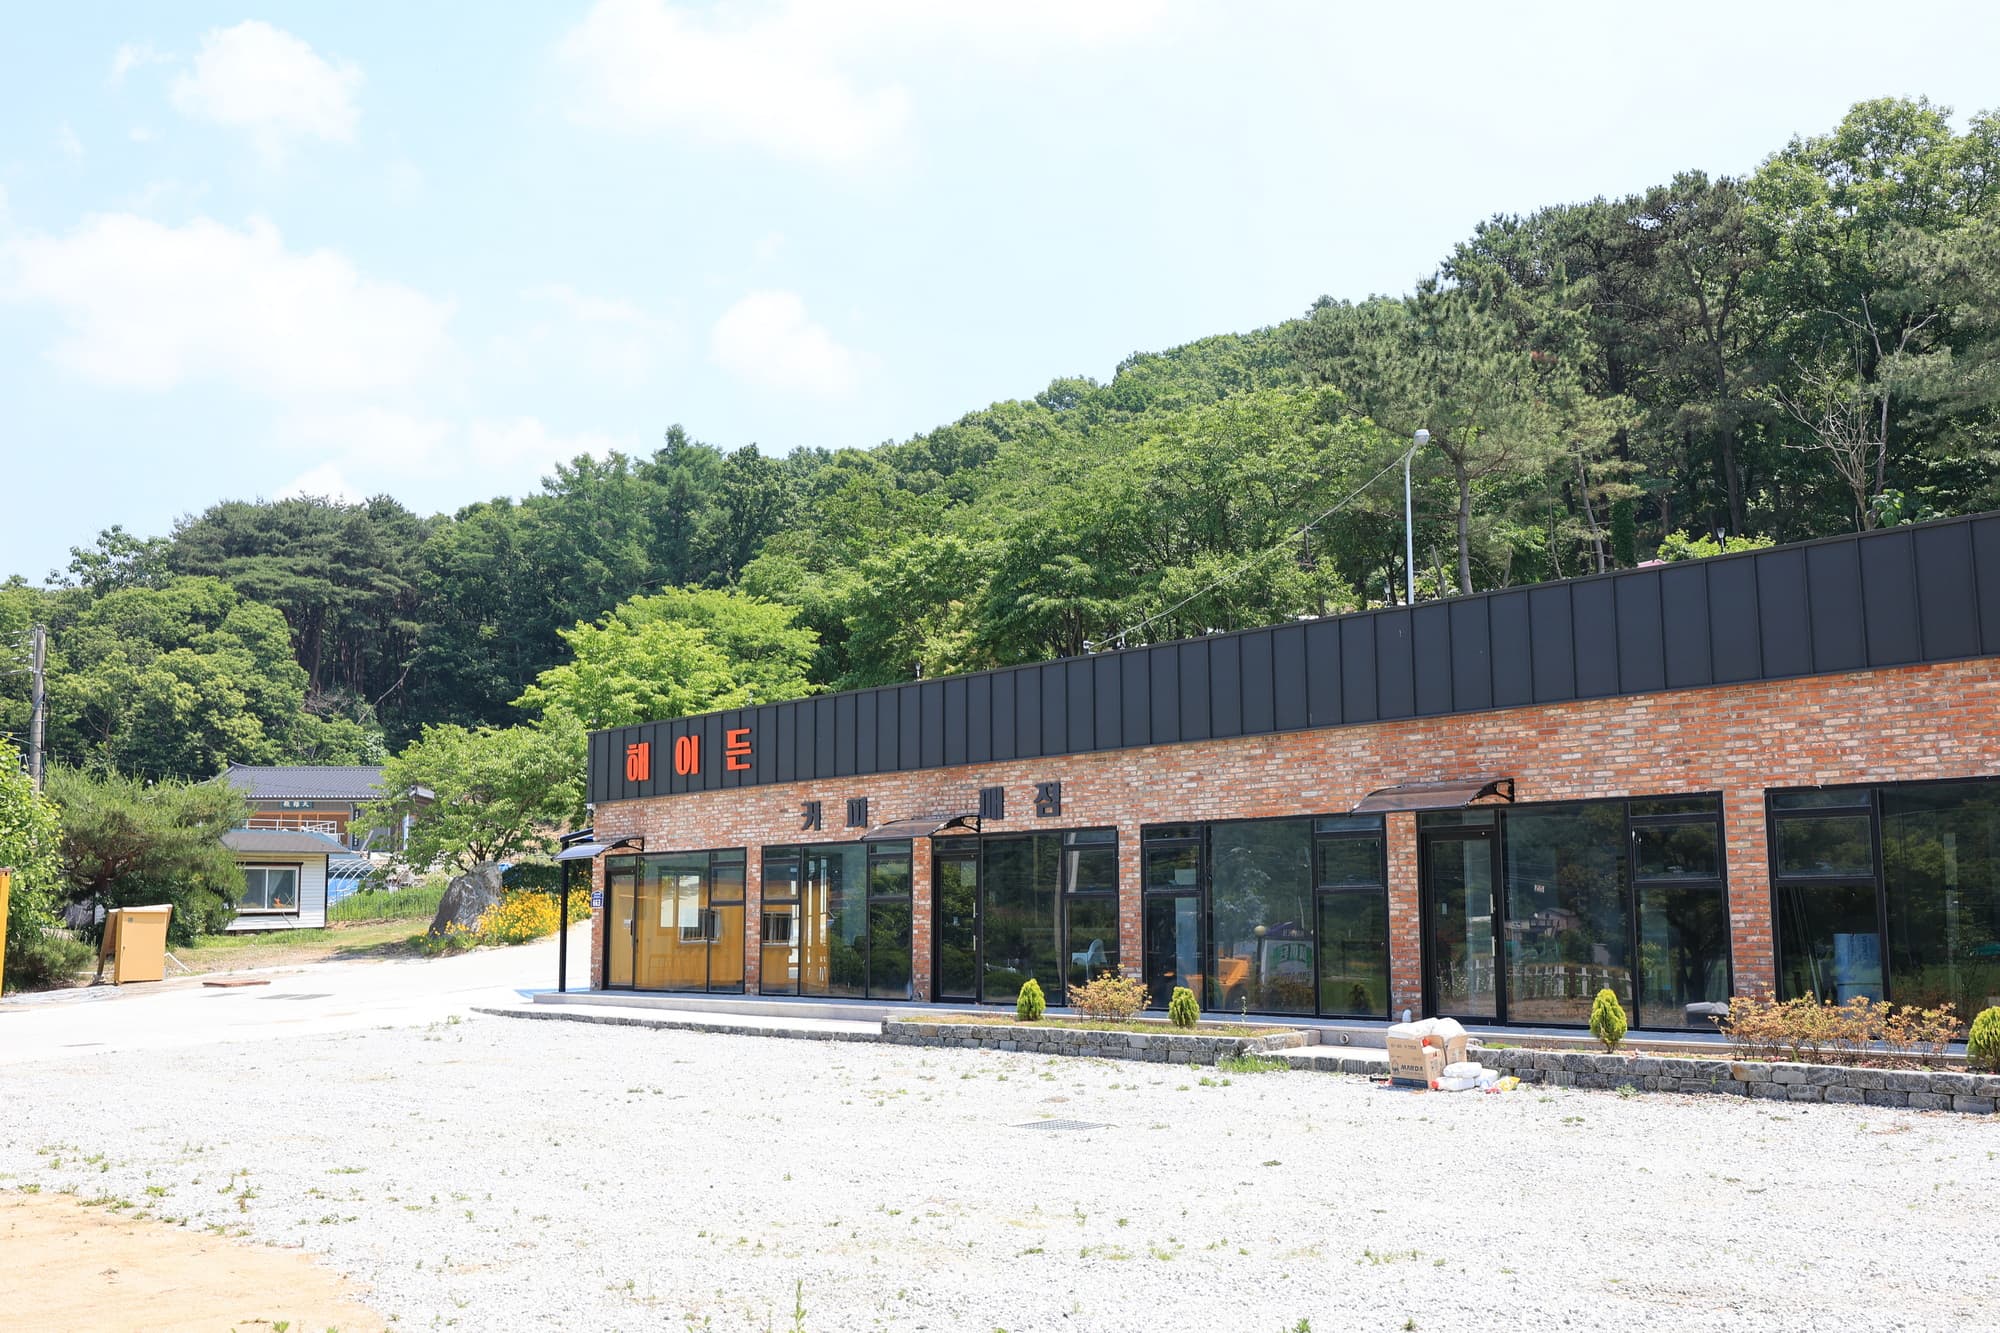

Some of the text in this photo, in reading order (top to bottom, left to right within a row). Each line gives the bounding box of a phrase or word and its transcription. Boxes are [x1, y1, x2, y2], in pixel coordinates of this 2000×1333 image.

[626, 728, 751, 782] 해이든
[801, 781, 1061, 831] 커피 매점
